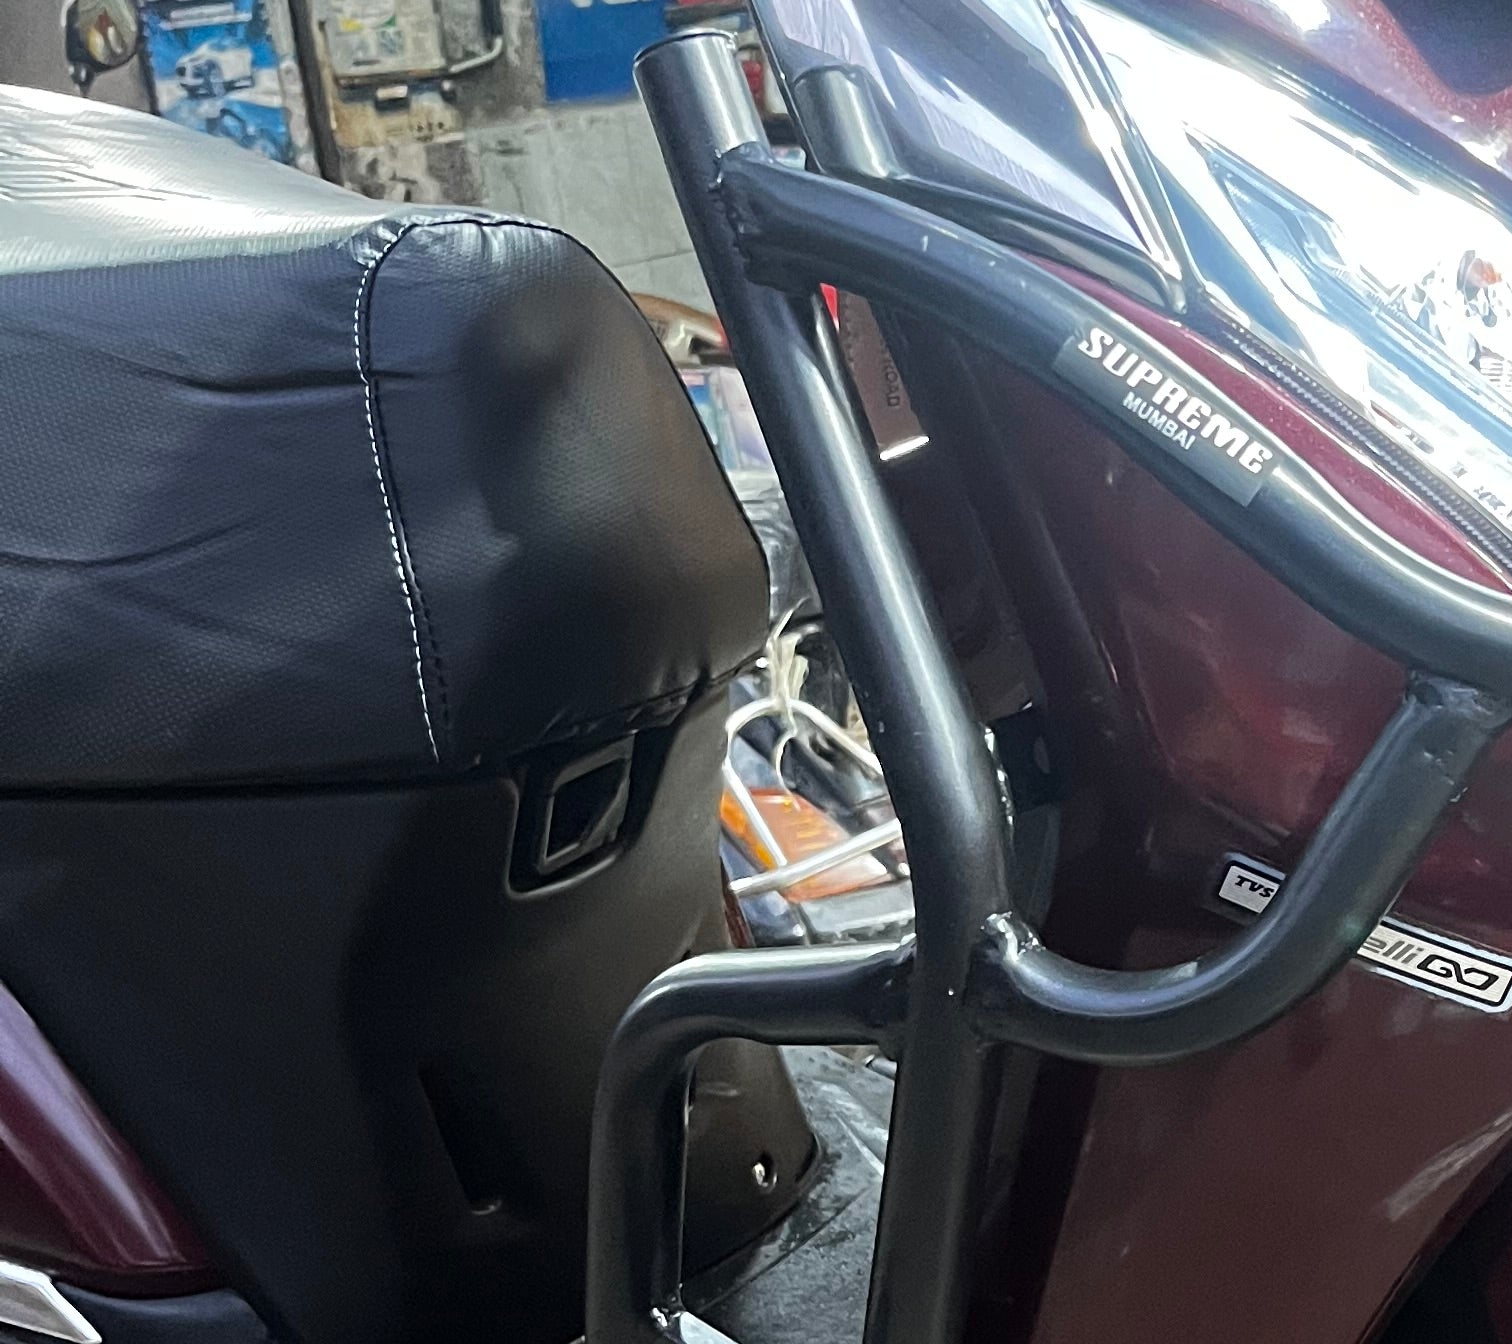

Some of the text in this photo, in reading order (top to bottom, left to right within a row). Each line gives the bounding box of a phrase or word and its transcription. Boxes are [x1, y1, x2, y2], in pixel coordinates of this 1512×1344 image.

[1077, 327, 1273, 474] SUPREME
[1122, 391, 1197, 451] MUMBAI
[1234, 873, 1275, 899] TVS
